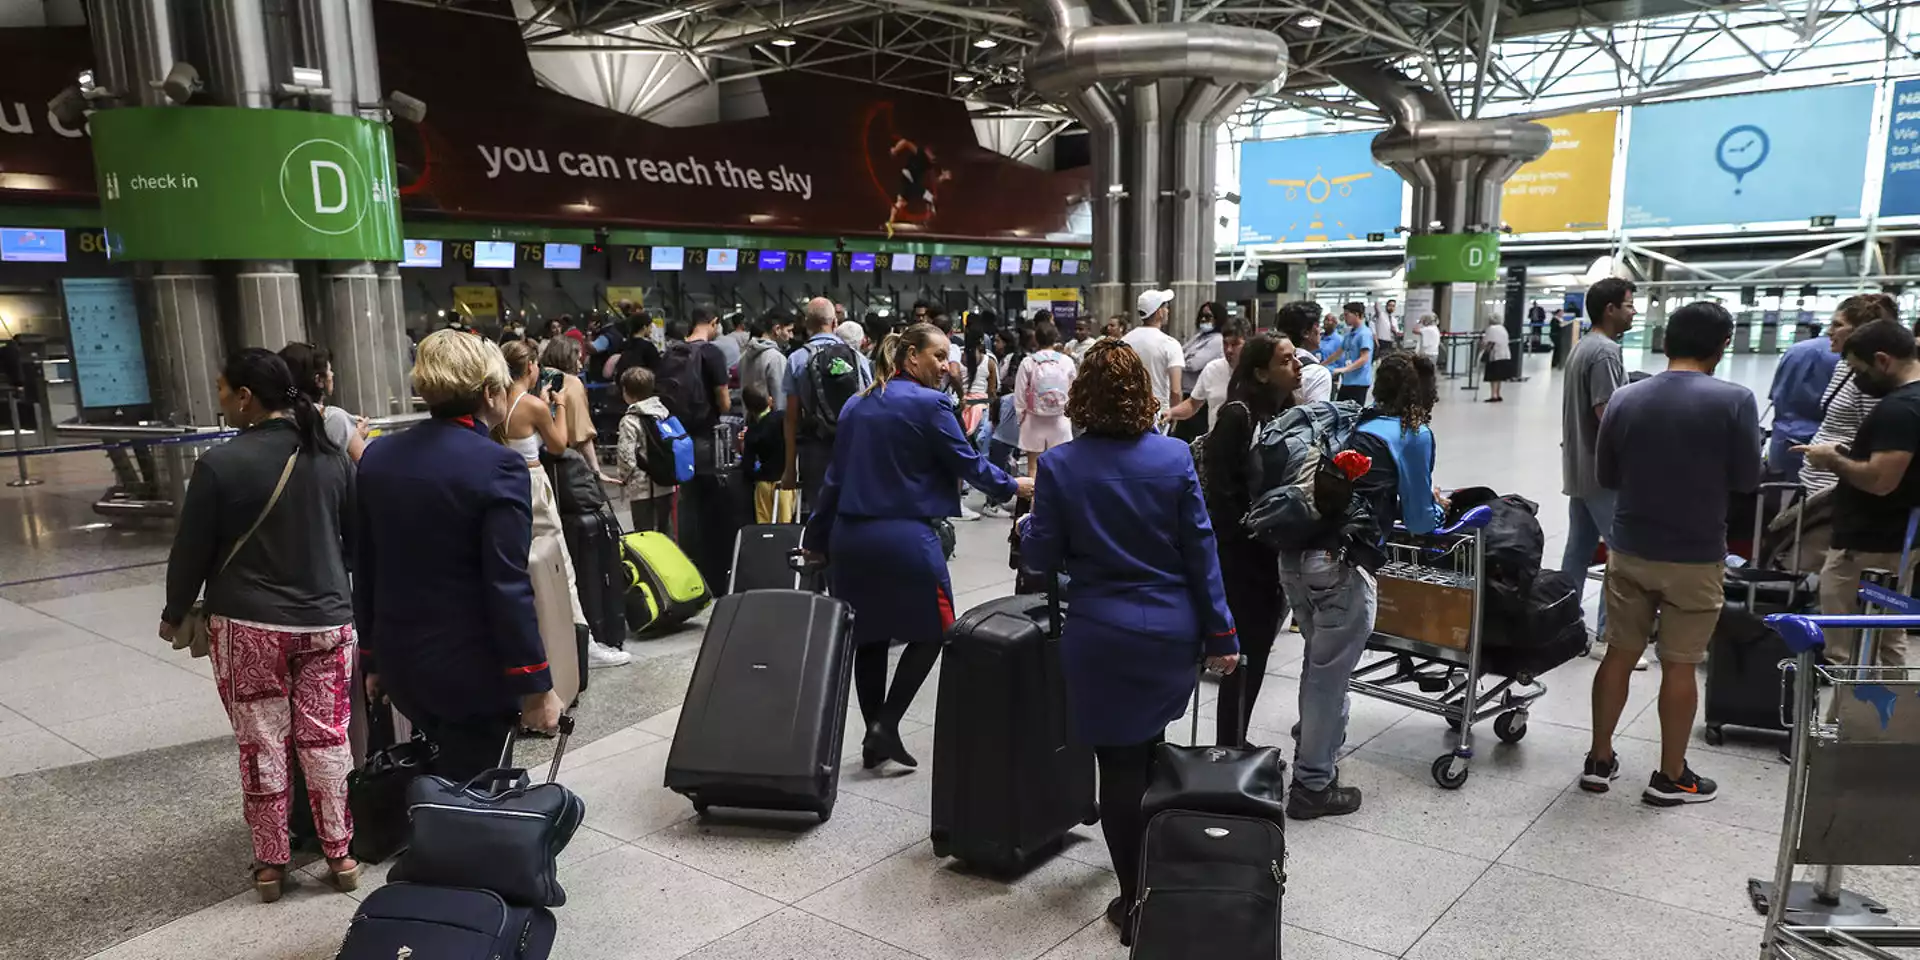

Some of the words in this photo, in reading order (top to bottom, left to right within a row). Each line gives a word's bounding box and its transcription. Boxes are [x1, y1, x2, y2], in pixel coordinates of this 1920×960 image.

[478, 144, 550, 179] you
[558, 151, 621, 179] can
[625, 156, 713, 186] reach
[714, 160, 765, 190] the
[768, 165, 813, 200] sky
[130, 174, 177, 191] check
[182, 173, 198, 189] in
[310, 160, 348, 213] D
[451, 243, 473, 260] 76
[521, 244, 542, 261] 75
[627, 248, 645, 262] 74
[688, 250, 704, 264] 73
[741, 251, 756, 264] 72
[788, 253, 802, 265] 71
[1469, 247, 1482, 266] D
